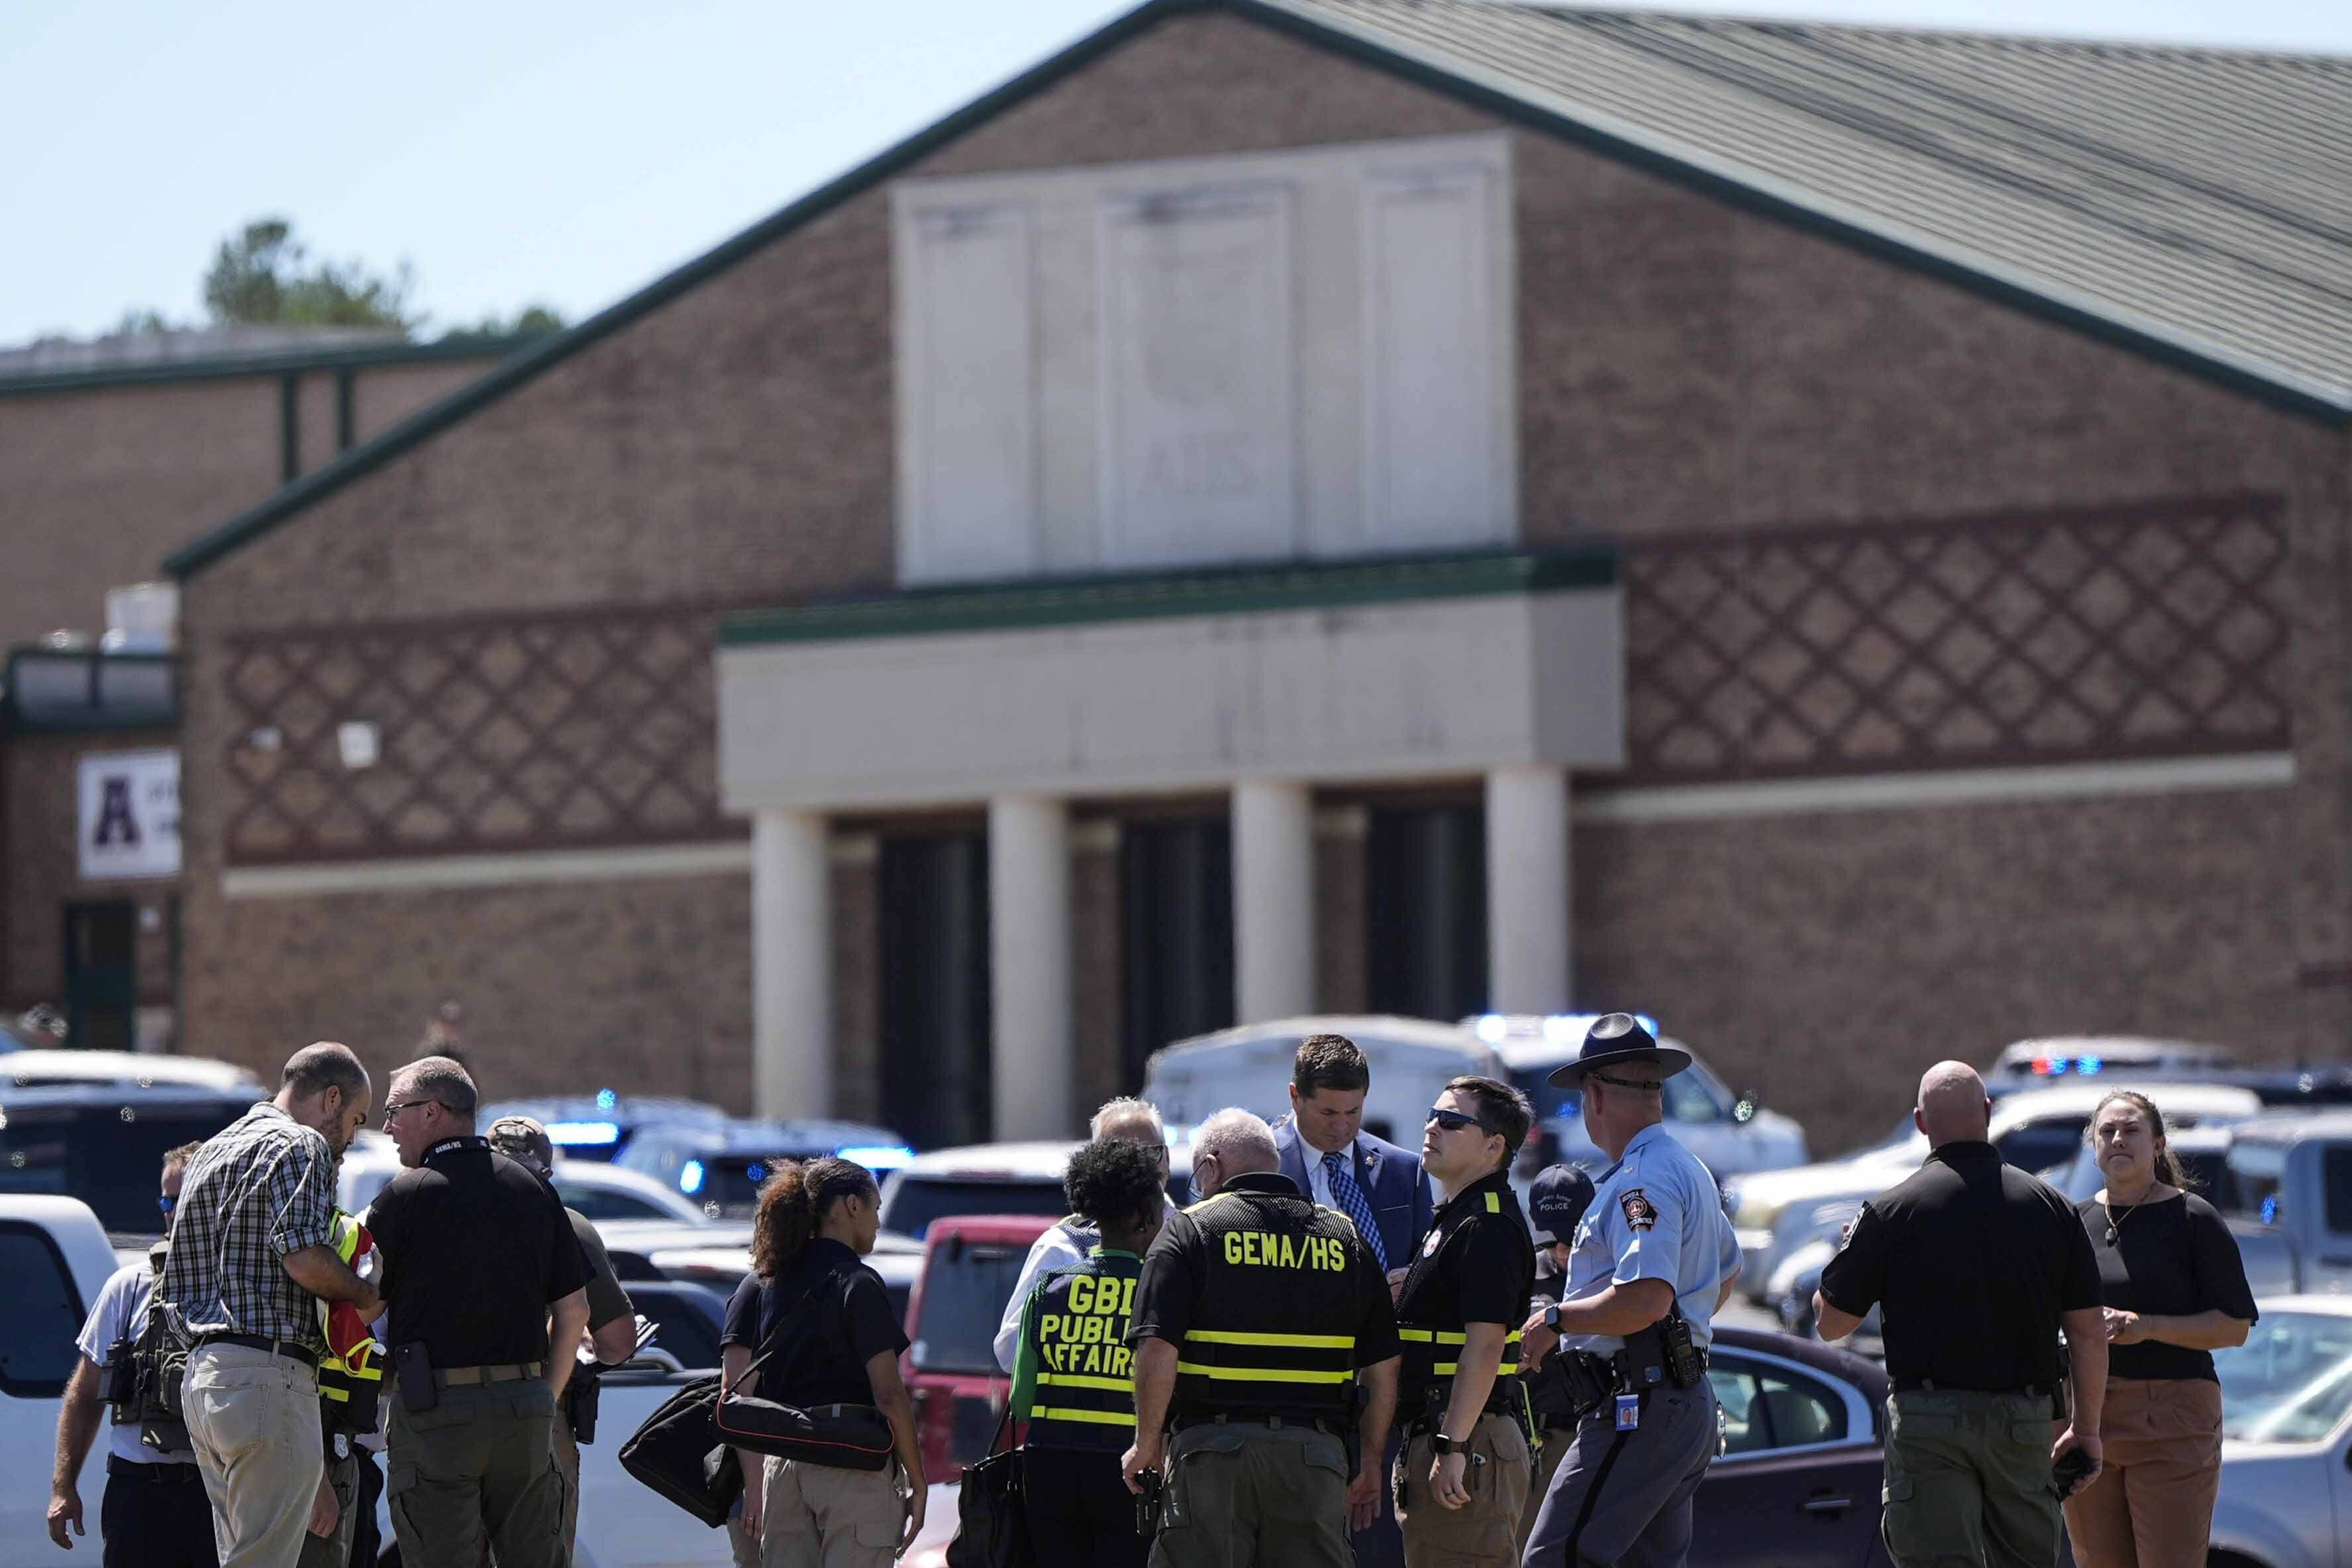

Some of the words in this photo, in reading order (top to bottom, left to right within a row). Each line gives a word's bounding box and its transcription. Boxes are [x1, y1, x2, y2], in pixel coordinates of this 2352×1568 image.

[1540, 1202, 1569, 1212] POLICE
[1224, 1231, 1345, 1271] GEMA/HS
[1068, 1275, 1137, 1316] GBI
[1040, 1314, 1131, 1346] PUBLI
